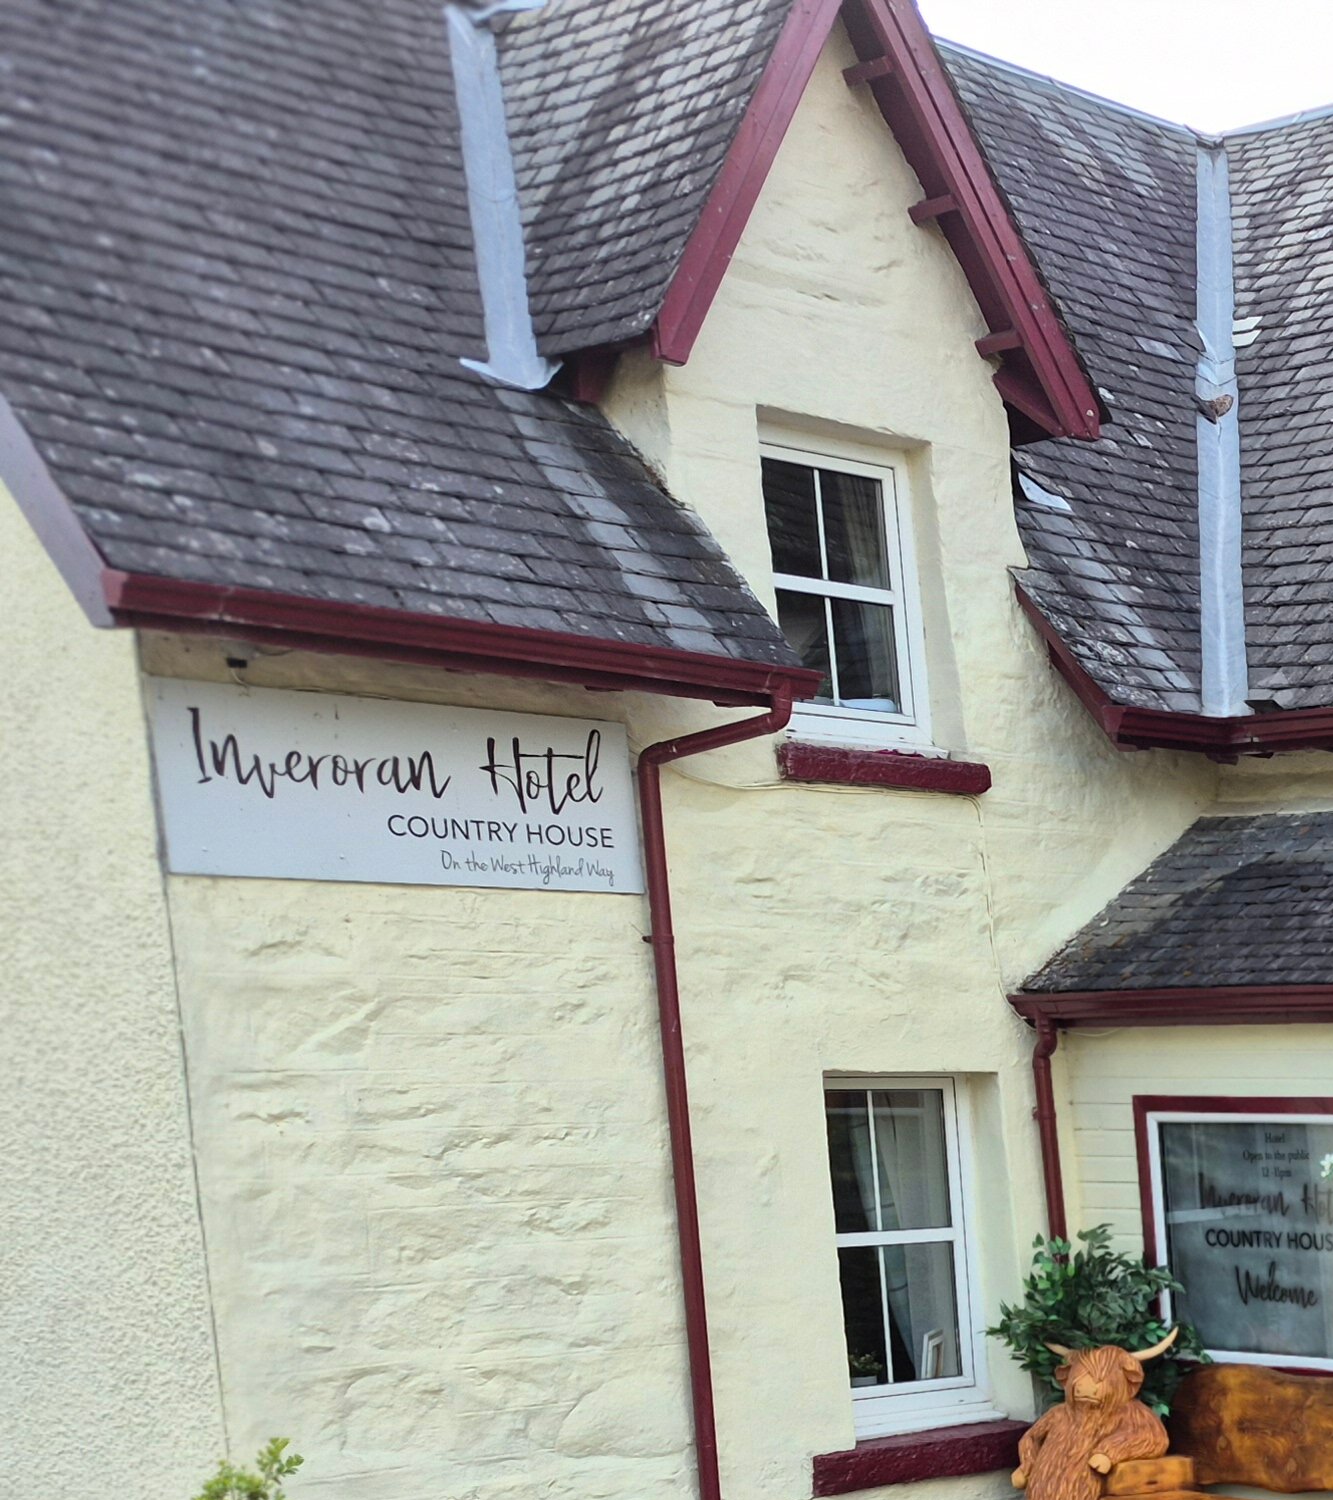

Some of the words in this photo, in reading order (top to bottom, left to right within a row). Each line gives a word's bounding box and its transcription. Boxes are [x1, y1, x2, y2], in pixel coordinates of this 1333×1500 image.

[187, 706, 452, 799] Inveroran
[479, 729, 604, 814] Hotel
[387, 814, 518, 844] COUNTRY
[526, 823, 615, 848] HOUSE
[441, 850, 461, 871] On
[465, 854, 488, 872] the
[490, 857, 526, 875] West
[527, 854, 584, 885] Highland
[585, 862, 615, 886] Way
[1242, 1149, 1264, 1164] Open
[1274, 1150, 1285, 1160] the
[1288, 1149, 1310, 1163] public
[1205, 1228, 1282, 1249] COUNTRY
[1235, 1261, 1318, 1309] Welcome
